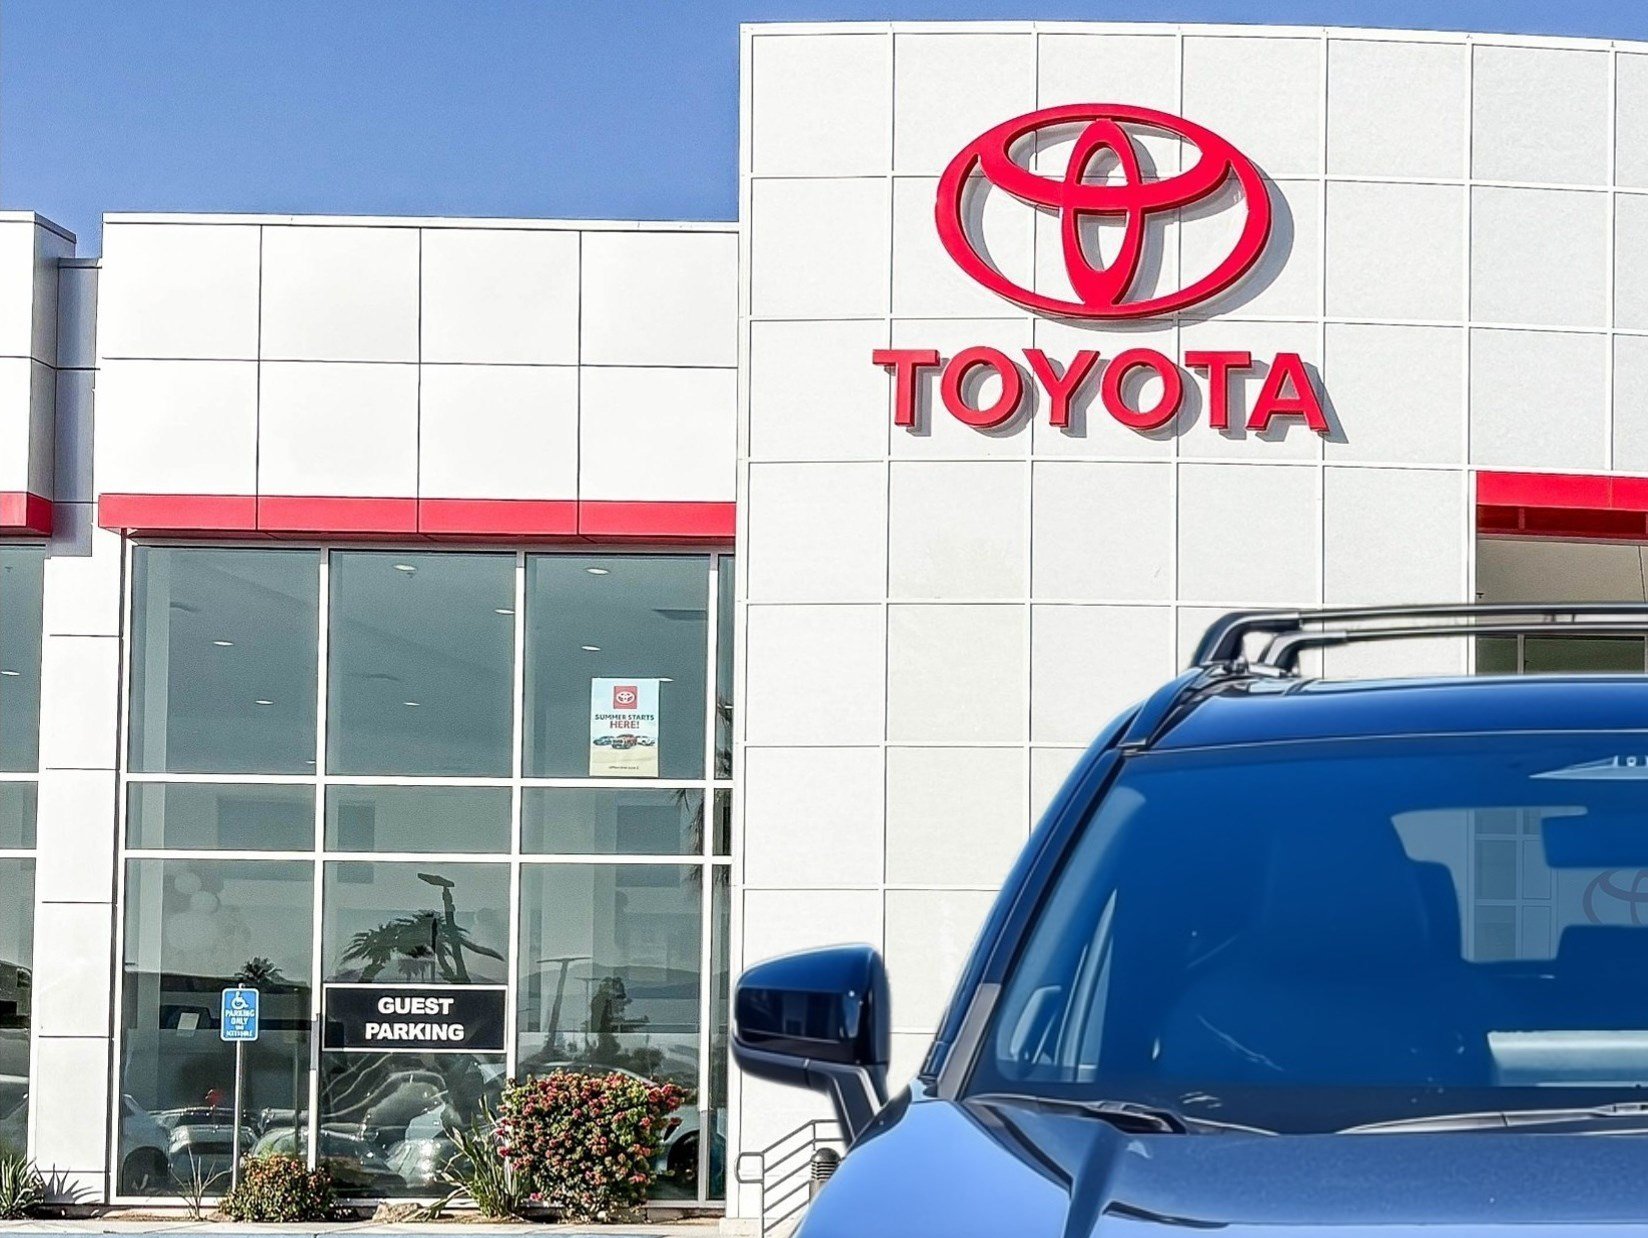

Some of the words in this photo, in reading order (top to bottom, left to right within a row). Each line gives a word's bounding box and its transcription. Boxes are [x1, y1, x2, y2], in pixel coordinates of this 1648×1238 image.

[872, 346, 1330, 432] TOYOTA
[594, 713, 627, 721] SUMMER
[609, 720, 640, 729] HERE!
[377, 997, 455, 1015] GUEST
[225, 1009, 255, 1017] PARKING
[230, 1017, 248, 1025] ONLY
[365, 1022, 465, 1041] PARKING
